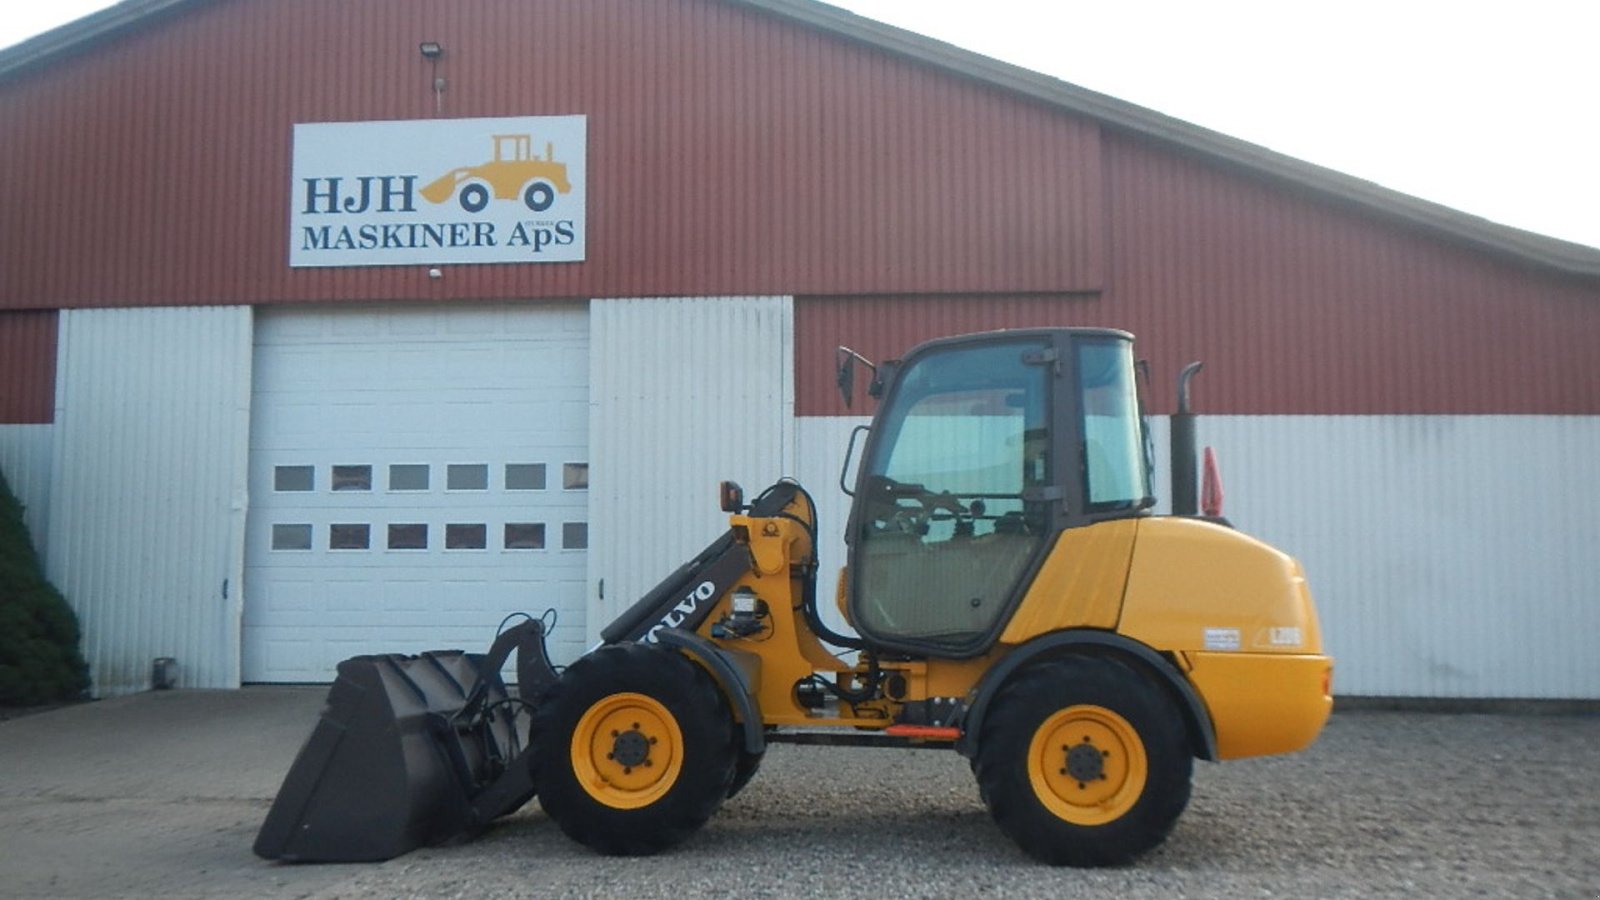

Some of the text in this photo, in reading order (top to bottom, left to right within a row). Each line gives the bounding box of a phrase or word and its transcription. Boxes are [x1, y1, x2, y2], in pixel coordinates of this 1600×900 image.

[302, 175, 418, 214] HJH
[302, 220, 574, 252] MASKINER ApS
[637, 581, 716, 644] OLVO
